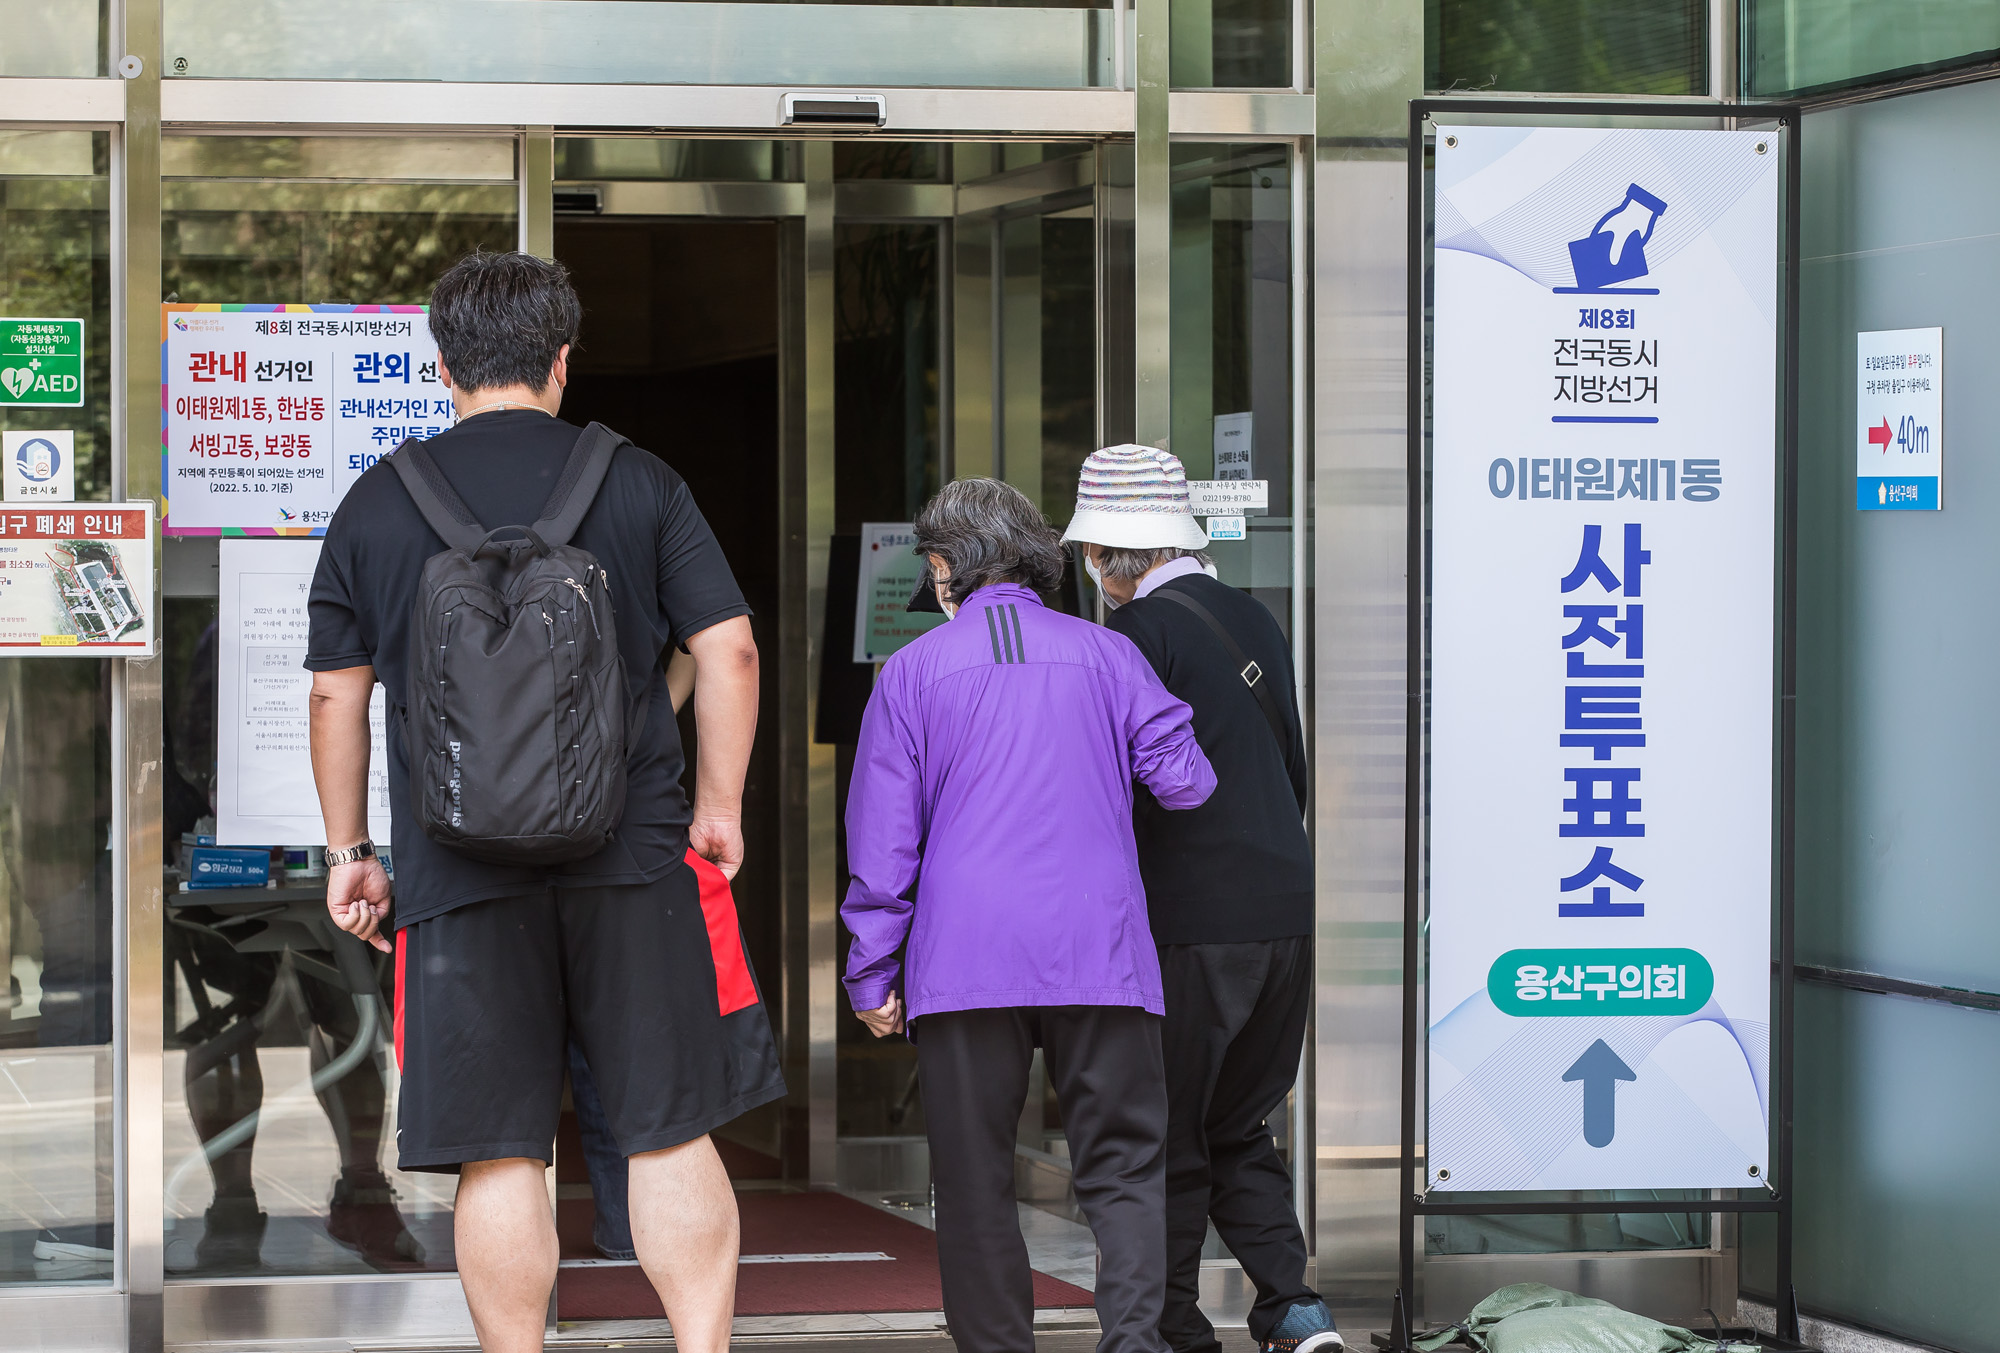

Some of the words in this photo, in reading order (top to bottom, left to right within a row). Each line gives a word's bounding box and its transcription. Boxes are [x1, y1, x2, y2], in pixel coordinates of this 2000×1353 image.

[17, 324, 63, 334] 자동제세동기
[255, 320, 292, 336] 제8회
[297, 320, 411, 337] 전국동시지방선거
[1578, 308, 1635, 330] 제8회
[10, 335, 70, 345] (자동심장충격기)
[25, 345, 56, 354] 설치시설
[1553, 338, 1659, 368] 전국동시
[188, 351, 247, 383] 관내
[254, 360, 313, 382] 선거인
[353, 351, 410, 384] 관외
[418, 361, 441, 383] 선
[33, 374, 78, 392] AED
[1553, 374, 1659, 404] 지방선거
[176, 396, 272, 423] 이태원제1동,
[277, 396, 325, 421] 한남동
[339, 399, 428, 419] 관내선거인
[433, 399, 457, 419] 지
[371, 426, 451, 446] 주민등록
[1897, 415, 1929, 454] 40m
[189, 433, 260, 461] 서빙고동,
[264, 433, 312, 458] 보광동
[177, 467, 206, 478] 지역에
[208, 467, 255, 478] 주민등록이
[257, 467, 294, 478] 되어있는
[296, 467, 324, 478] 선거인
[1488, 457, 1723, 502] 이태원제1동
[20, 486, 58, 494] 금연시설
[209, 482, 240, 493] (2022.
[242, 483, 251, 492] 5.
[254, 483, 269, 492] 10.
[271, 482, 293, 493] 기준)
[1192, 482, 1213, 490] 구의회
[1888, 484, 1918, 502] 용산구의회
[1202, 494, 1252, 502] 02)2199-8780
[35, 515, 75, 535] 폐쇄
[83, 515, 122, 535] 안내
[9, 560, 33, 569] 최소화
[253, 607, 273, 615] 2022년
[1558, 522, 1651, 918] 사전투표소
[449, 740, 463, 828] patagonia
[1514, 964, 1687, 1001] 용산구의회
